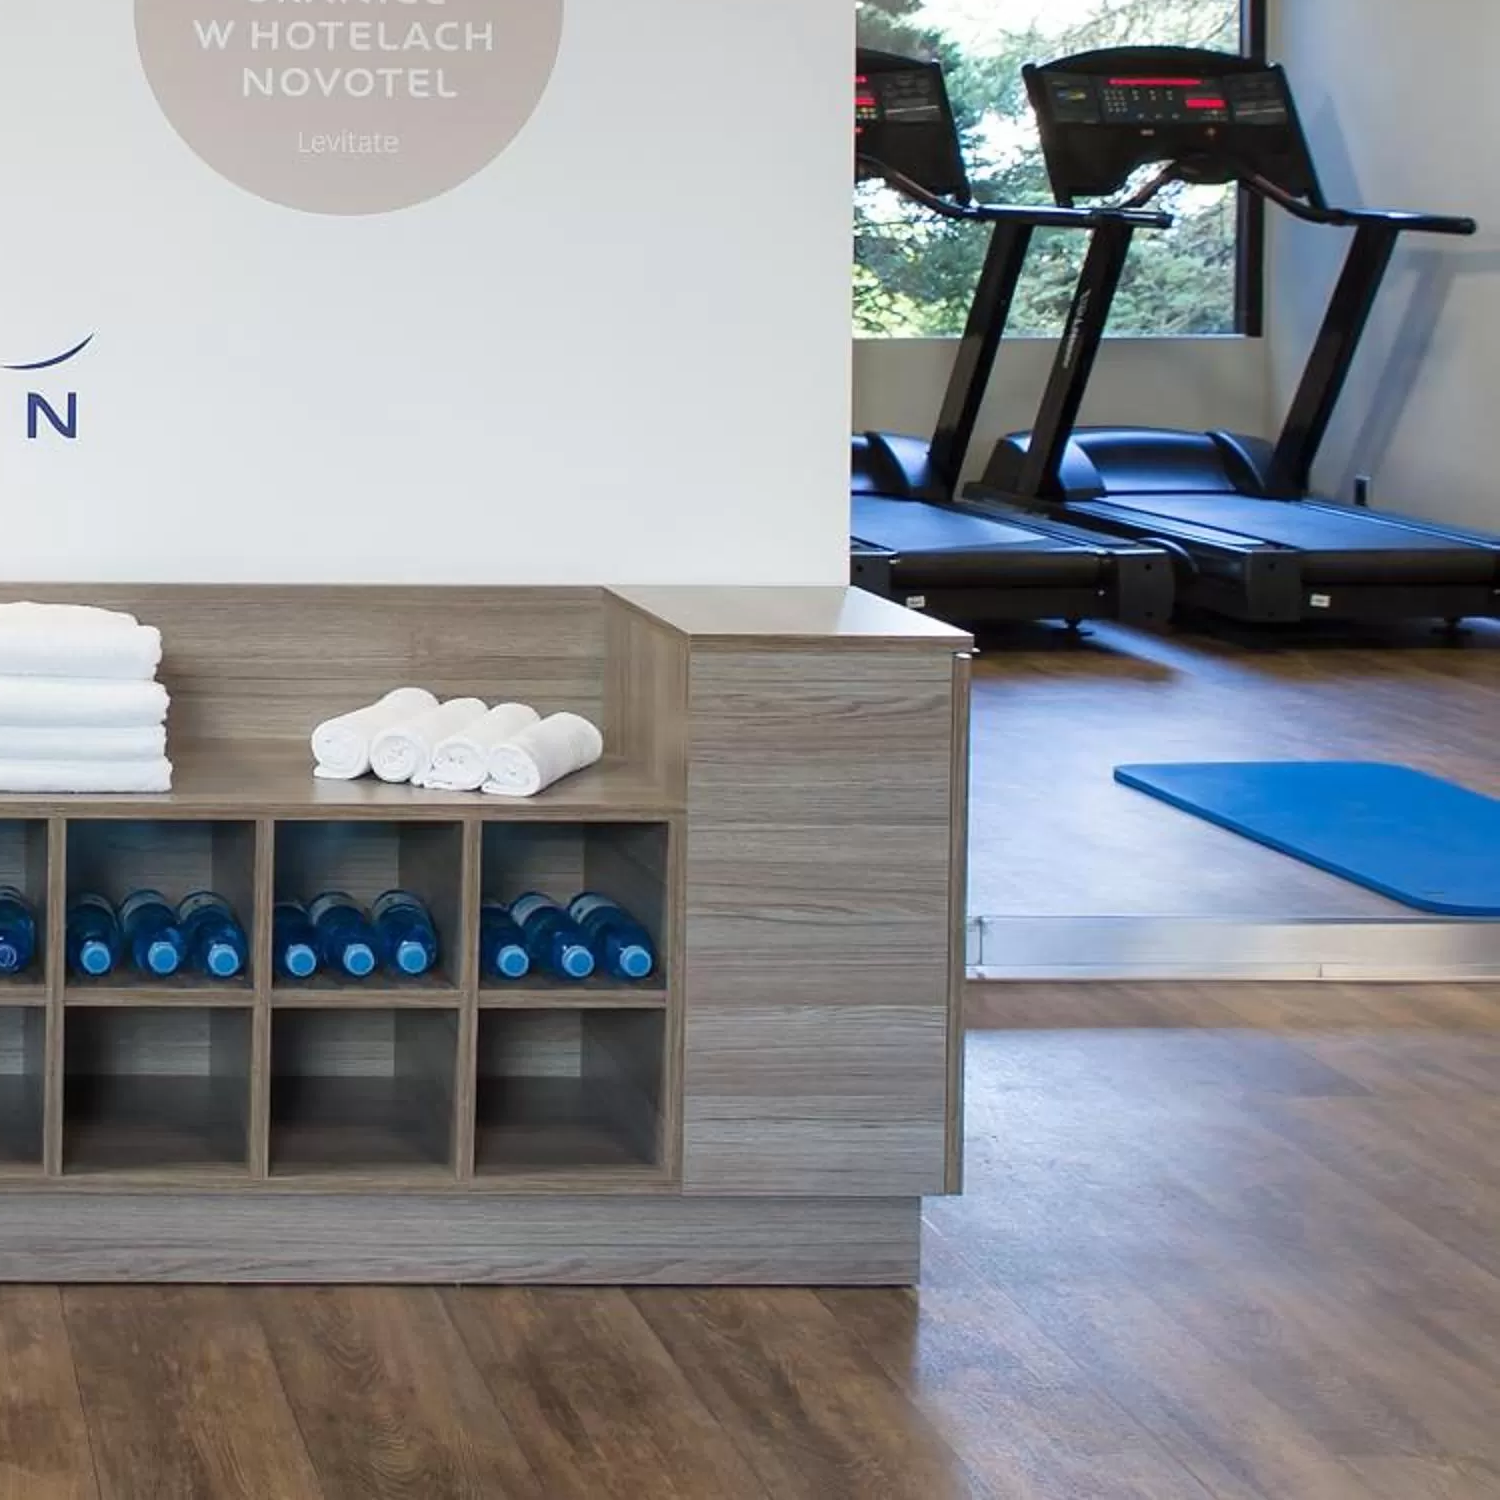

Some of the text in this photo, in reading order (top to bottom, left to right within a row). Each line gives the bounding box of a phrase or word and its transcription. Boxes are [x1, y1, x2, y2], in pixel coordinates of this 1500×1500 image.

[193, 19, 493, 51] W HOTELACH
[242, 67, 458, 98] NOVOTEL
[298, 130, 400, 154] Levitate
[27, 391, 77, 439] N
